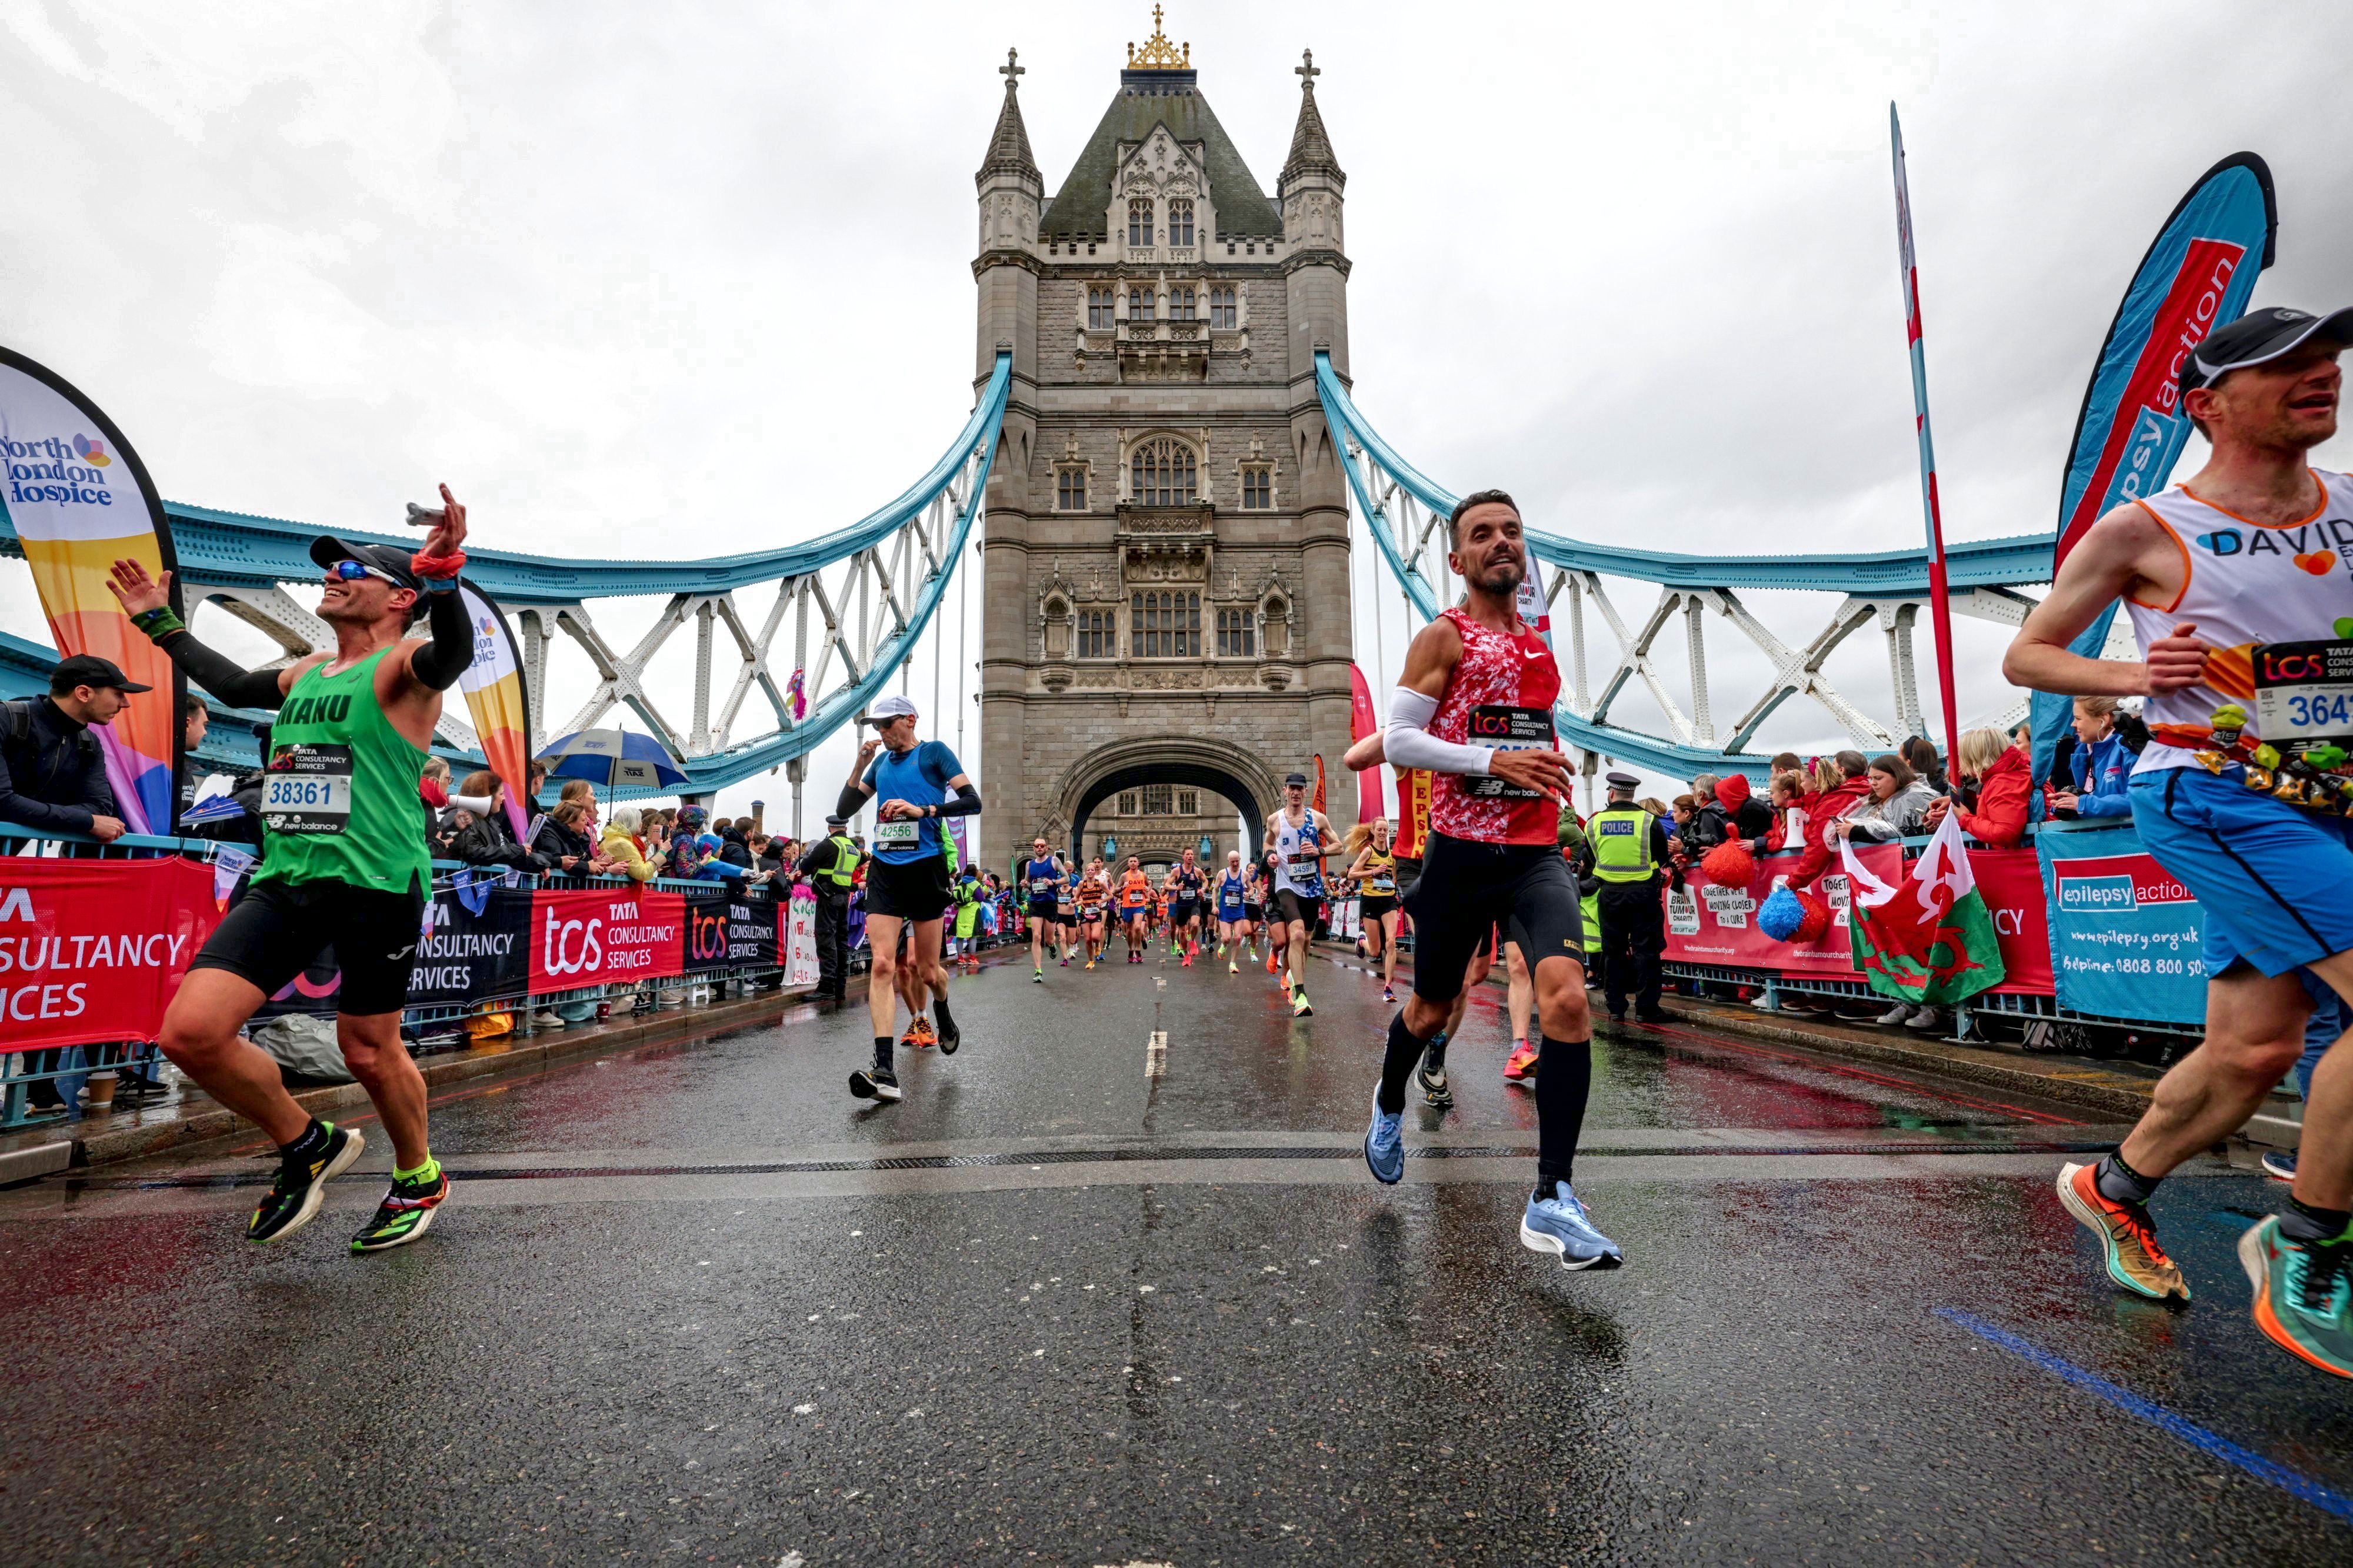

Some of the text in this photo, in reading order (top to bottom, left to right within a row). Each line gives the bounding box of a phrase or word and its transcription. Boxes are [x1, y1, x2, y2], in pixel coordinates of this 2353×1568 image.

[8, 459, 106, 484] London
[2210, 519, 2353, 556] DAVID
[1518, 597, 1532, 606] CHARITY
[2264, 652, 2323, 680] tcs
[276, 695, 352, 726] MANU
[2288, 694, 2353, 726] 364
[1475, 712, 1508, 734] tcs
[1511, 720, 1549, 729] CONSULTANCY
[295, 755, 347, 763] CONSULTANCY
[269, 782, 331, 805] 38361
[301, 822, 338, 830] balance
[881, 825, 911, 838] 42556
[1601, 823, 1632, 833] POLICE
[1293, 864, 1312, 873] 34597
[1703, 886, 1730, 897] TOGETHER
[1824, 877, 1849, 891] TOGET
[1831, 896, 1849, 908] MOVI
[2064, 885, 2131, 906] epilepsy
[609, 902, 639, 921] TATA
[729, 904, 750, 920] TATA
[1709, 900, 1753, 910] MOVING CLOSER
[1730, 915, 1744, 925] CURE
[1839, 914, 1845, 923] TO
[608, 926, 675, 945] CONSULTANCY
[692, 906, 726, 960] tcs
[729, 924, 773, 939] CONSULTANCY
[2071, 926, 2198, 950] www.epilepsy.org.uk
[415, 934, 514, 958] NSULTANCY
[545, 906, 602, 976] tcs
[728, 943, 758, 959] SERVICES
[1684, 945, 1735, 955] thebraintumourcharity.org
[608, 949, 651, 969] SERVICES
[2063, 955, 2114, 973] helpline:
[2116, 958, 2151, 973] 0808
[2156, 959, 2182, 974] 800
[407, 966, 471, 991] RVICES
